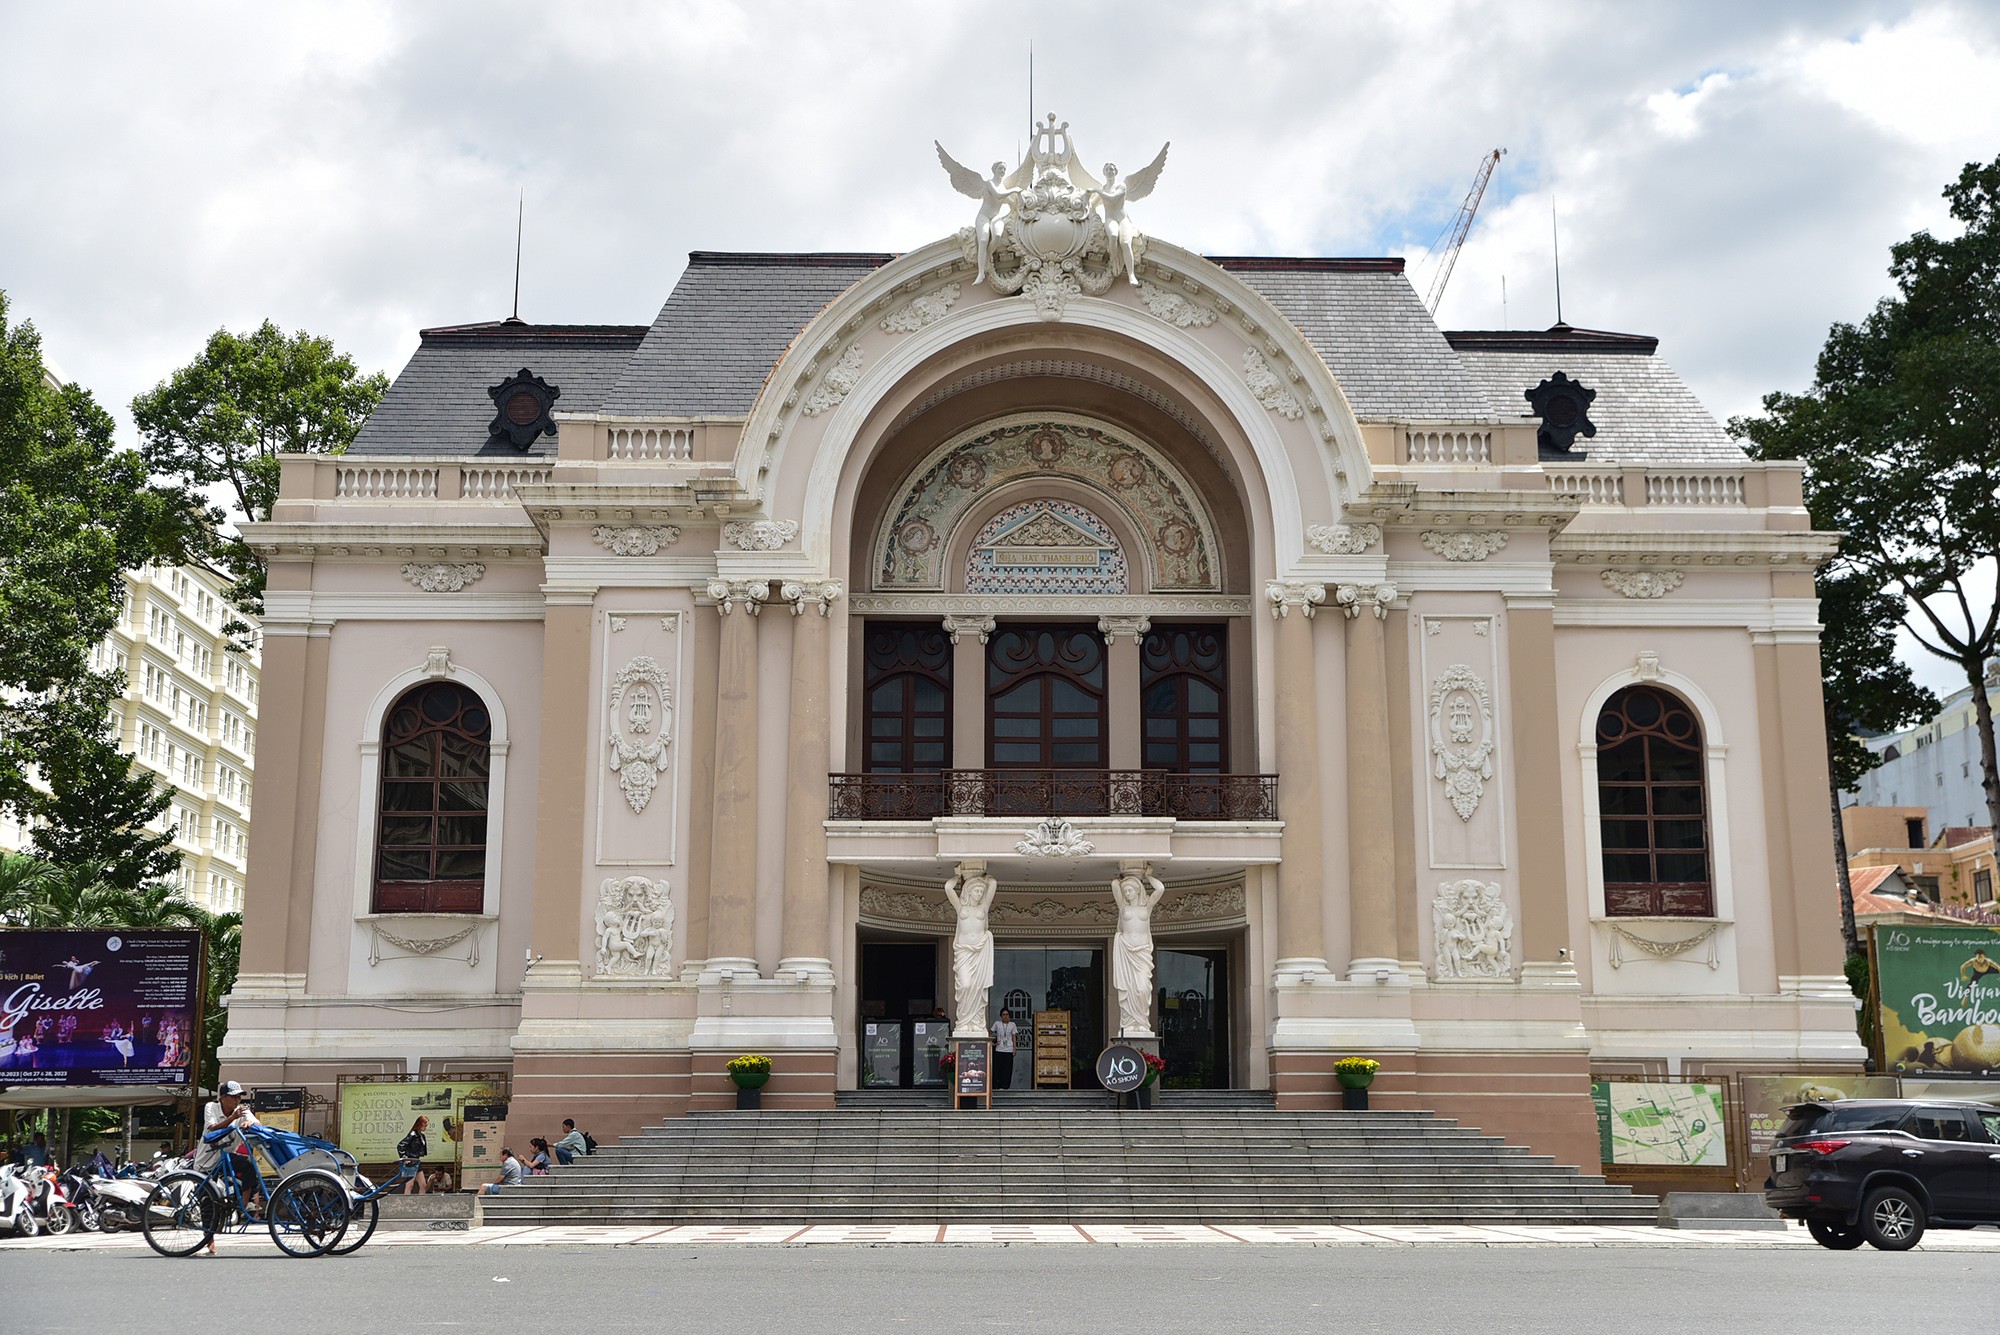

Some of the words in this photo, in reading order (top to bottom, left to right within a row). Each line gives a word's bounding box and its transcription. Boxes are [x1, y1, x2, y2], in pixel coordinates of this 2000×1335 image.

[0, 982, 104, 1030] Giselle
[1911, 993, 2000, 1026] Bambo
[1118, 1074, 1138, 1083] SHOW
[352, 1099, 404, 1110] SAIGON
[352, 1109, 404, 1121] OPERA
[351, 1122, 404, 1134] HOUSE
